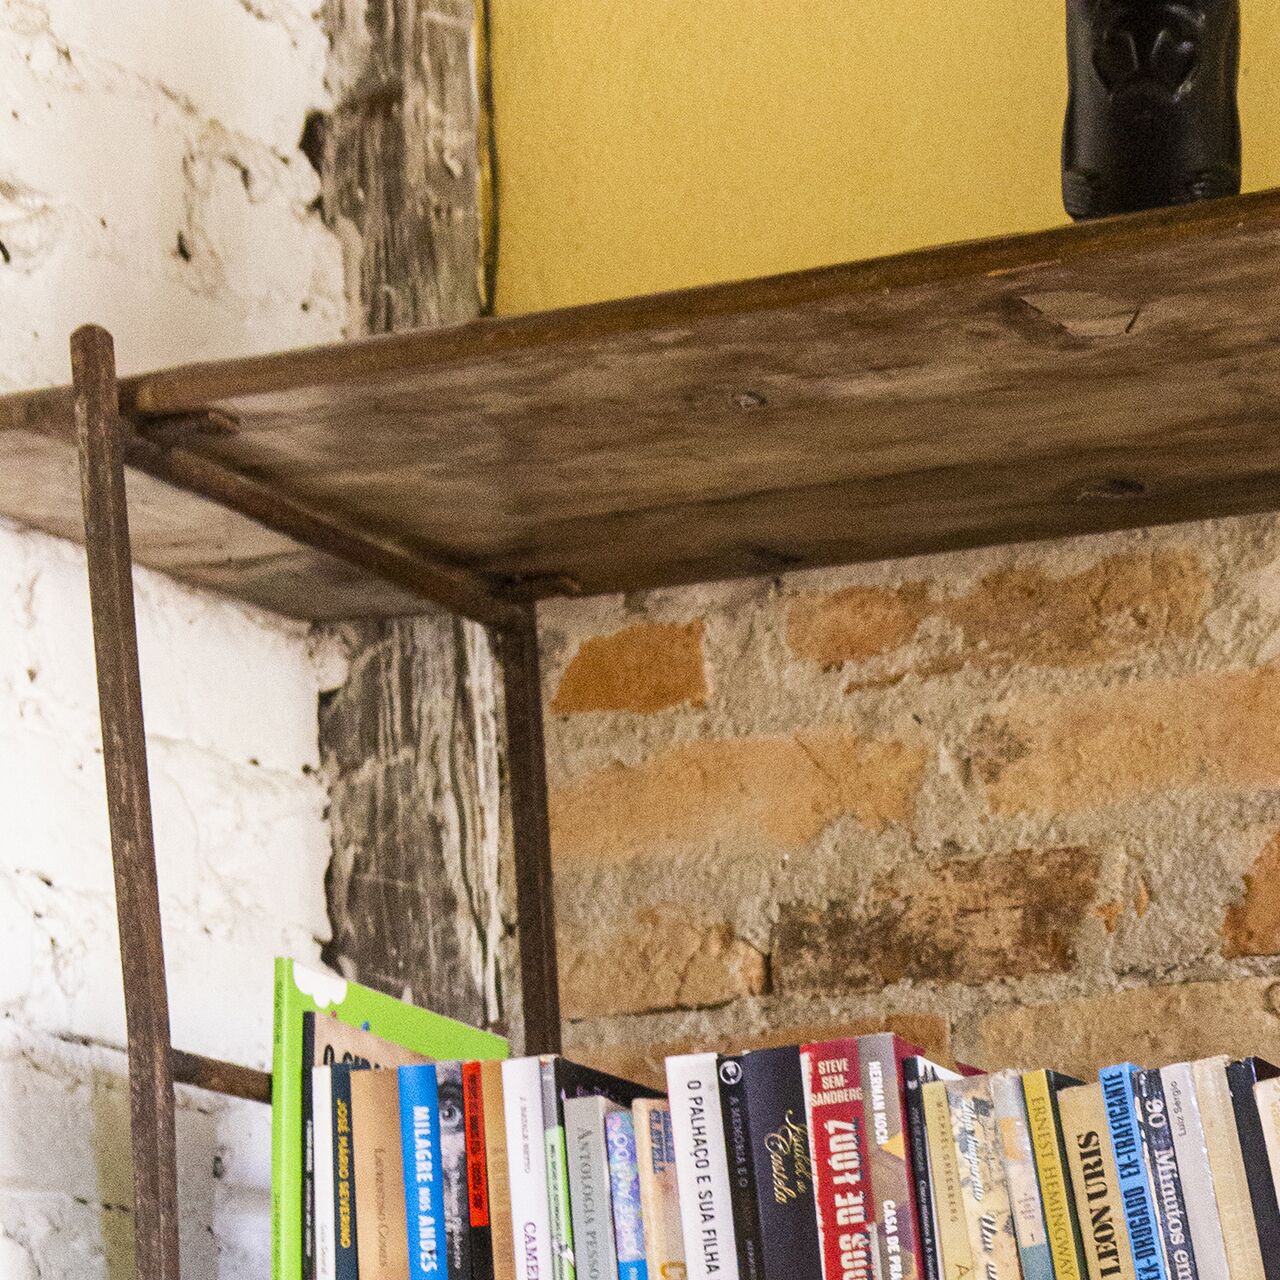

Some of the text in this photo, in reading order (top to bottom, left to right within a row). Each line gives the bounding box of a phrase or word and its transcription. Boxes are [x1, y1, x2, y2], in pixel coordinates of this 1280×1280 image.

[687, 1080, 701, 1090] O
[818, 1058, 850, 1076] STEVE
[822, 1073, 848, 1088] SEM-
[811, 1087, 864, 1107] SANDBERG
[868, 1061, 890, 1145] HERMAN KOCH
[1145, 1098, 1168, 1129] 90
[688, 1101, 710, 1169] PALHAÇO
[1103, 1070, 1141, 1181] EX-TRAFICANTE
[413, 1105, 434, 1183] MILAGRE
[697, 1175, 712, 1185] E
[1030, 1096, 1071, 1278] ERNEST HEMINGWAY
[1155, 1147, 1187, 1247] Minutos
[699, 1188, 714, 1223] SUA
[834, 1191, 867, 1227] DE
[882, 1200, 899, 1235] CASA
[1077, 1130, 1122, 1279] LEON URIS
[418, 1215, 438, 1273] ANDES
[702, 1229, 722, 1275] FILHA
[886, 1236, 900, 1252] DE
